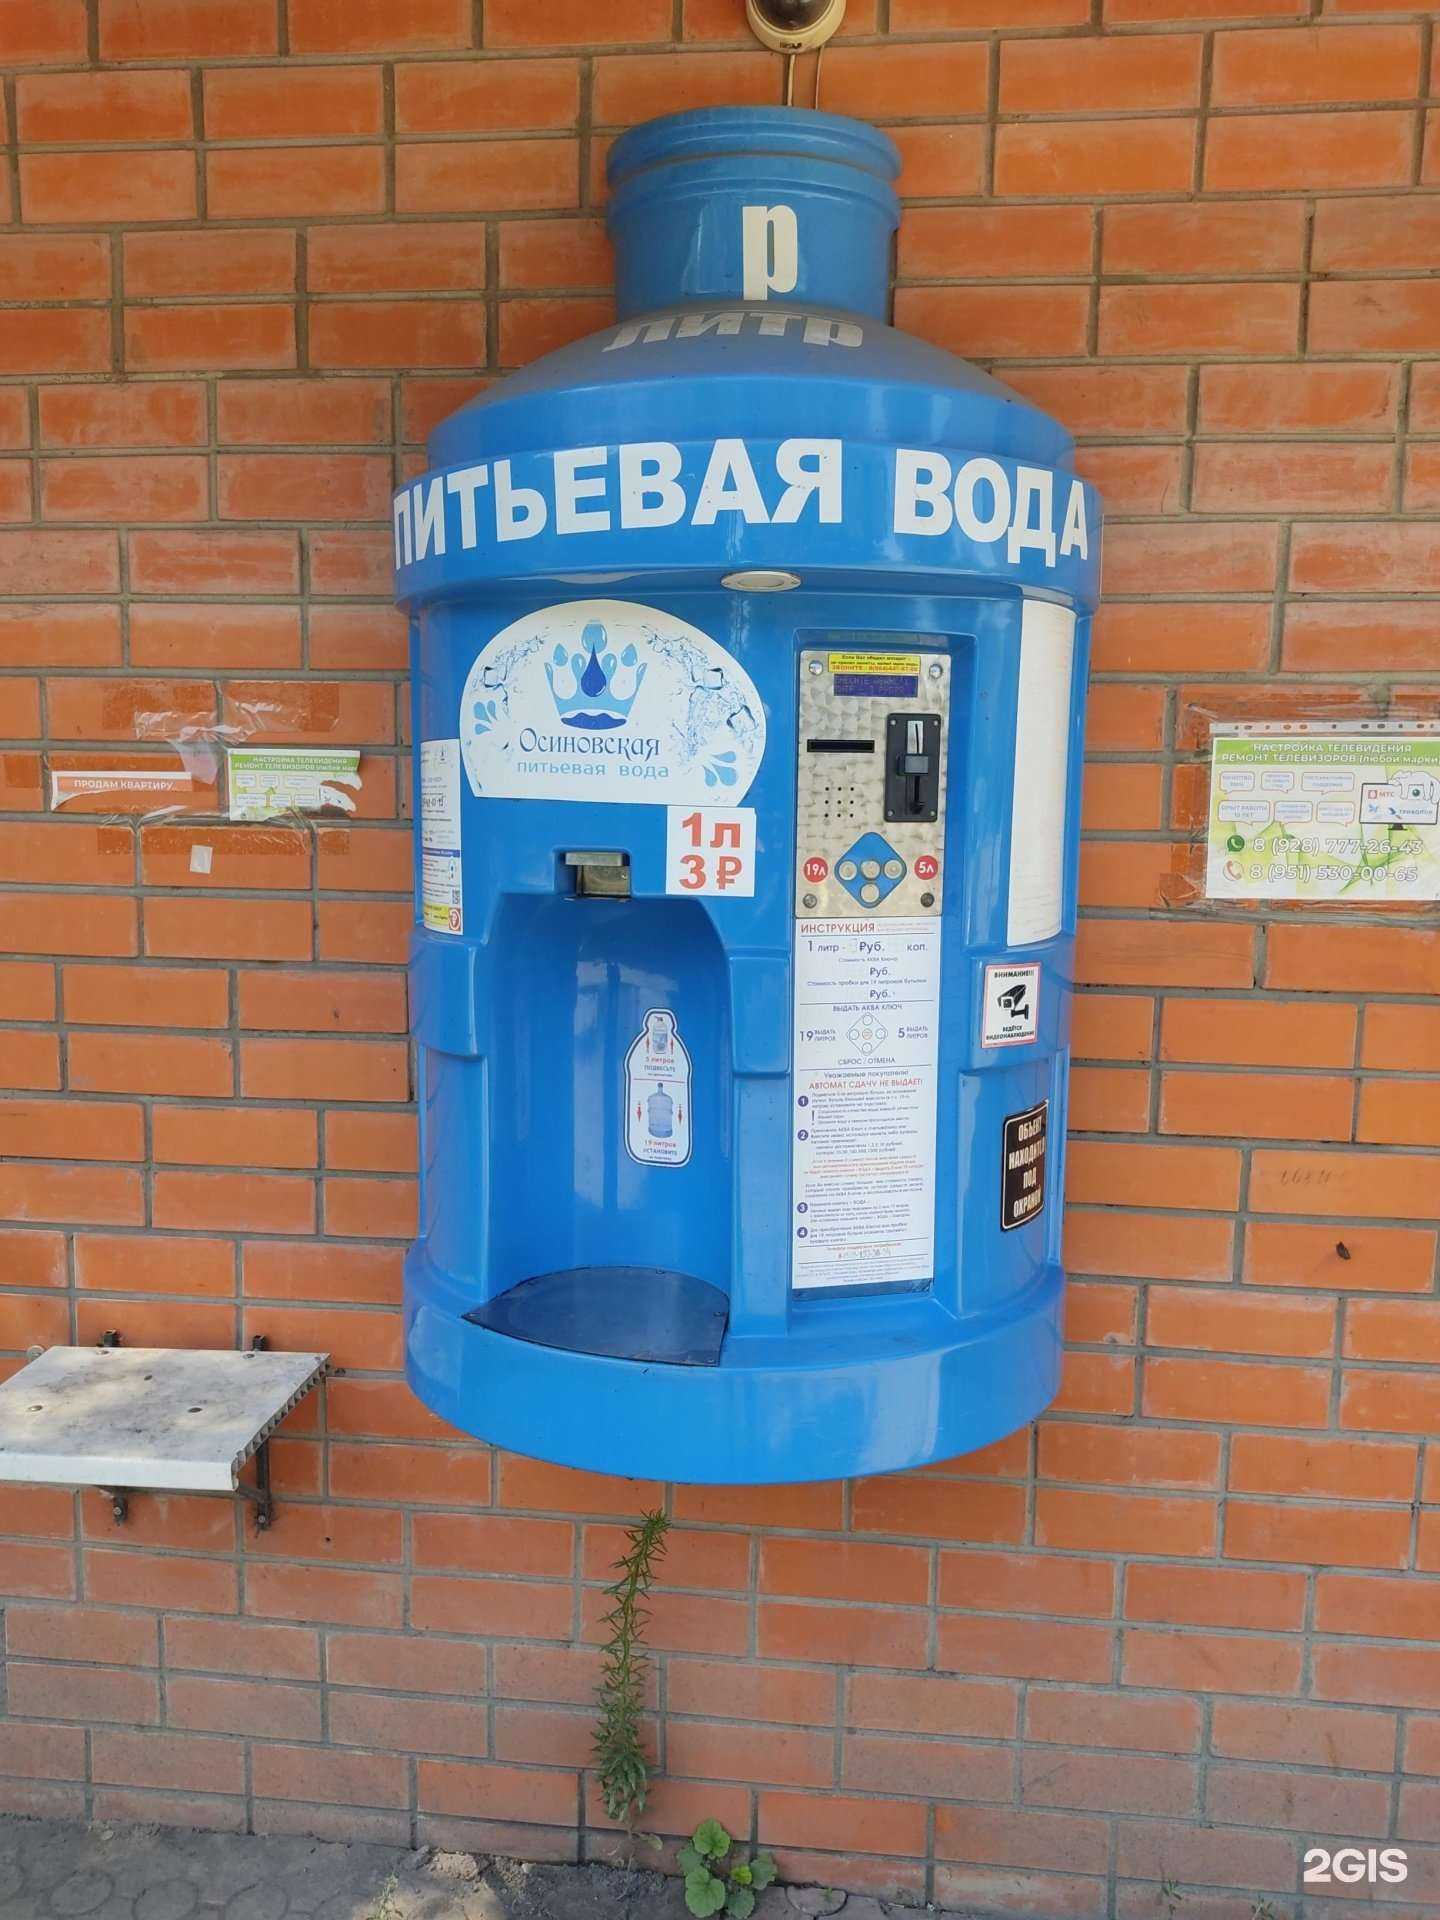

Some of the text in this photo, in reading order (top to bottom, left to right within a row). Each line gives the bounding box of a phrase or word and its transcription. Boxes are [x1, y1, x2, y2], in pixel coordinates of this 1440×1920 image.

[601, 311, 863, 352] литр
[393, 437, 1089, 570] ПИТЬЕВАЯ ВОДА
[519, 728, 660, 761] Осиновская
[1253, 743, 1412, 753] НАСТРОЙКА ТЕЛЕВИДЕНИЯ
[1222, 753, 1268, 762] РЕМОНТ
[1273, 753, 1356, 763] ТЕЛЕВИЗОРОВ
[516, 761, 669, 779] питьевая вода
[73, 778, 175, 791] ПРОДАМ КВАРТИРУ
[682, 812, 741, 848] 1 л
[1253, 838, 1423, 856] 8 (928) 777-26-43
[679, 854, 706, 889] 3
[806, 863, 826, 876] 19л
[918, 862, 934, 874] 5л
[1250, 864, 1419, 882] 8 (951) 530-00-65
[801, 923, 875, 934] ИНСТРУКЦИЯ
[808, 940, 813, 952] 1
[817, 944, 840, 953] литр
[833, 1004, 860, 1012] ВЫДАТЬ
[800, 1030, 814, 1042] 19
[898, 1027, 906, 1039] 5
[809, 1081, 848, 1090] АВТОМАТ
[849, 1080, 878, 1089] СДАЧУ
[879, 1079, 889, 1087] НЕ
[1023, 1166, 1037, 1189] ПОД
